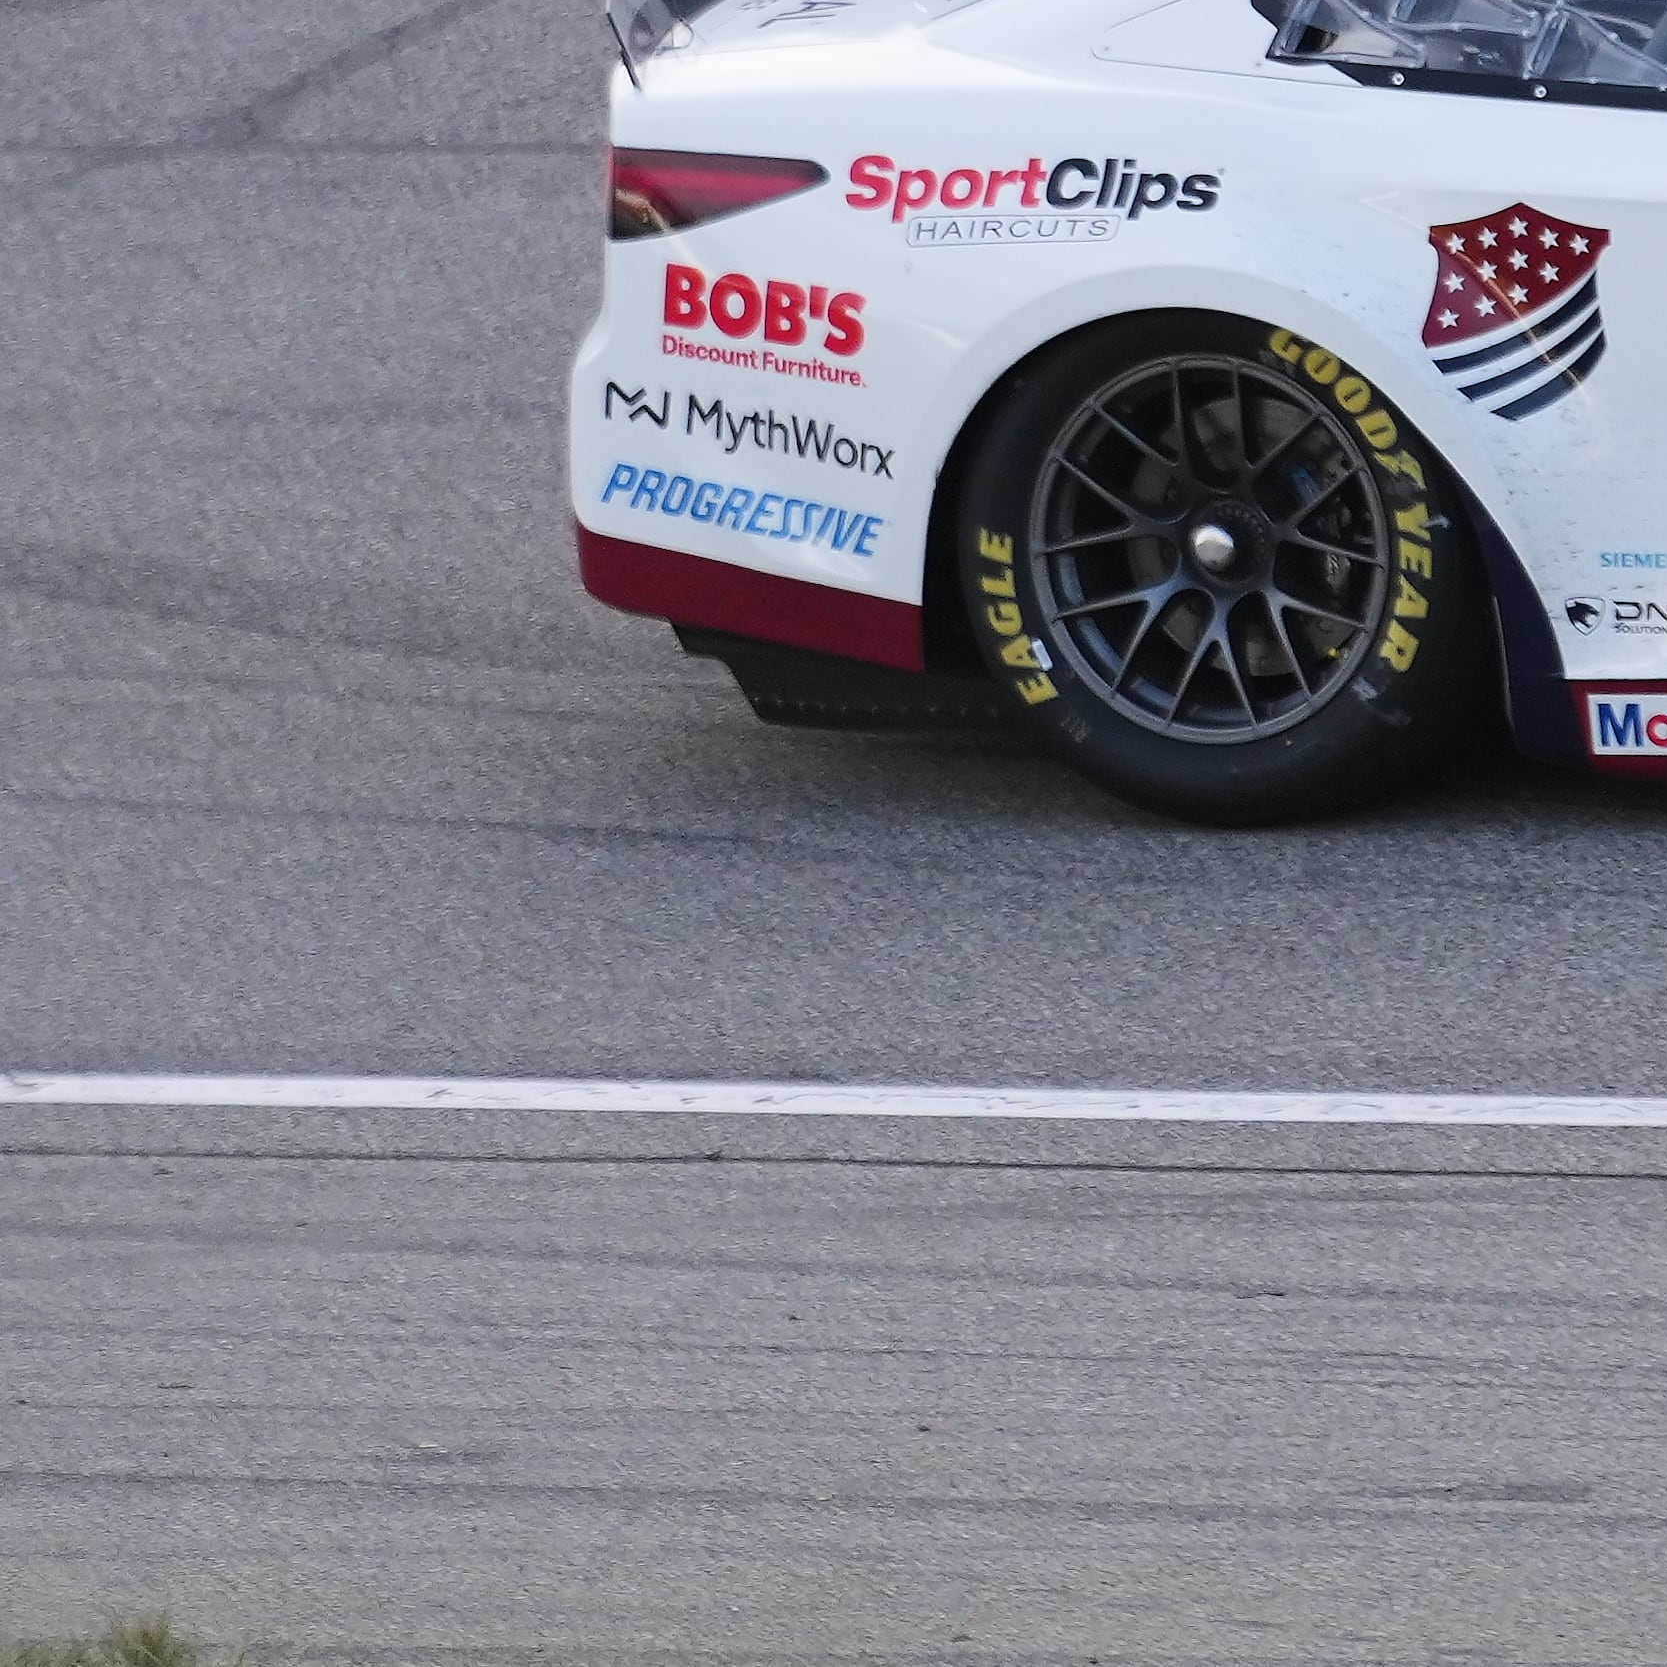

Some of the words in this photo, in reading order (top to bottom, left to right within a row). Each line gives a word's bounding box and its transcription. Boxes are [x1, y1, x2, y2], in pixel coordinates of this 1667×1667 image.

[914, 218, 1112, 241] HAIRCUTS
[662, 334, 759, 370] Discount
[663, 262, 868, 357] BOB'S
[686, 392, 897, 481] MythWorx
[601, 462, 886, 558] PROGRESSIVE
[977, 526, 1060, 706] EAGLE
